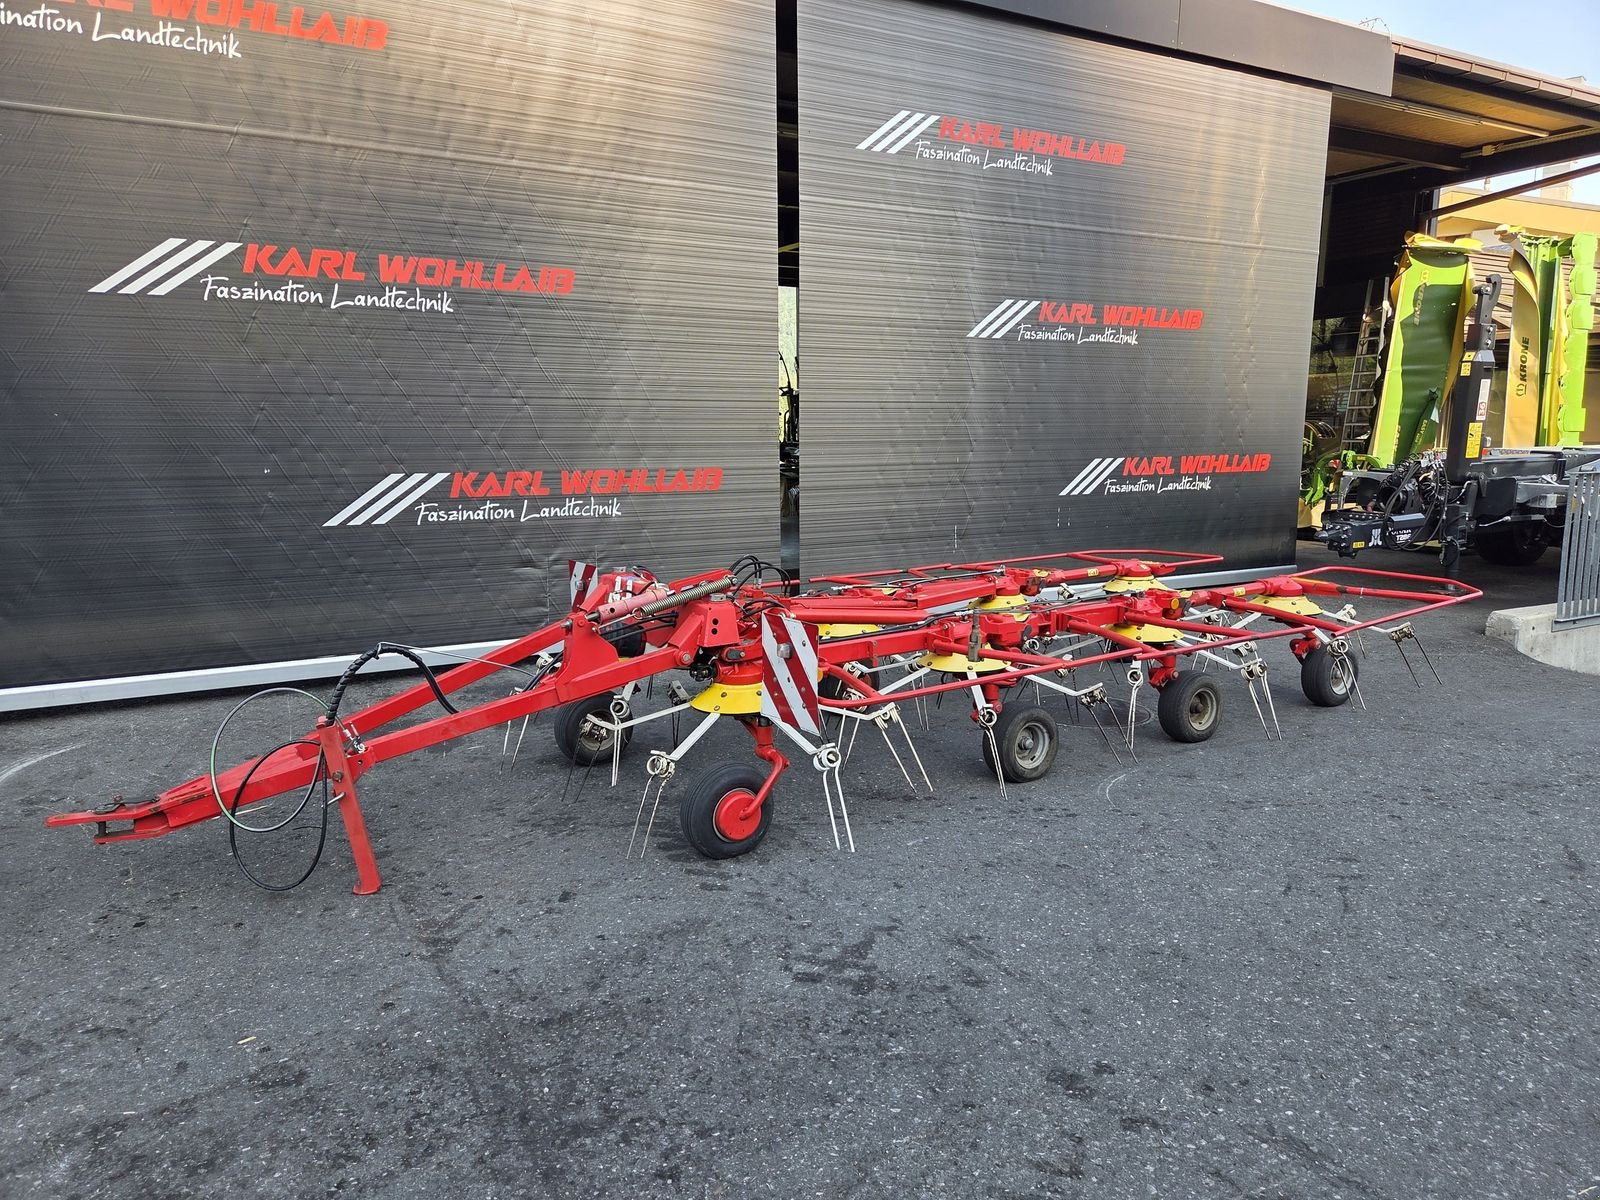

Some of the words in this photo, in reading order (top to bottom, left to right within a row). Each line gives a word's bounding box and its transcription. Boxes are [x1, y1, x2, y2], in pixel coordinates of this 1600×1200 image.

[0, 2, 83, 34] ination
[92, 12, 242, 59] Landtechnik
[150, 0, 389, 50] WOHLLAIB
[915, 139, 980, 164] Faszination
[983, 149, 1054, 177] Landtechnik
[939, 116, 1005, 149] KARL
[1013, 126, 1127, 166] WOHLLAIB
[243, 243, 366, 282] KARL
[378, 253, 576, 294] WOHLLAIB
[200, 275, 324, 303] Faszination
[330, 283, 454, 314] Landtechnik
[1017, 322, 1075, 342] Faszination
[1077, 326, 1139, 346] Landtechnik
[1039, 300, 1097, 325] KARL
[1102, 303, 1205, 331] WOHLLAIB
[1519, 336, 1530, 382] KRONE
[450, 470, 550, 499] KARL
[561, 467, 723, 496] WOHLLAIB
[1122, 455, 1175, 477] KARL
[1180, 452, 1272, 475] WOHLLAIB
[1104, 477, 1156, 496] Faszination
[1156, 474, 1212, 495] Landtechnik
[414, 499, 515, 526] Faszination
[520, 496, 622, 523] Landtechnik
